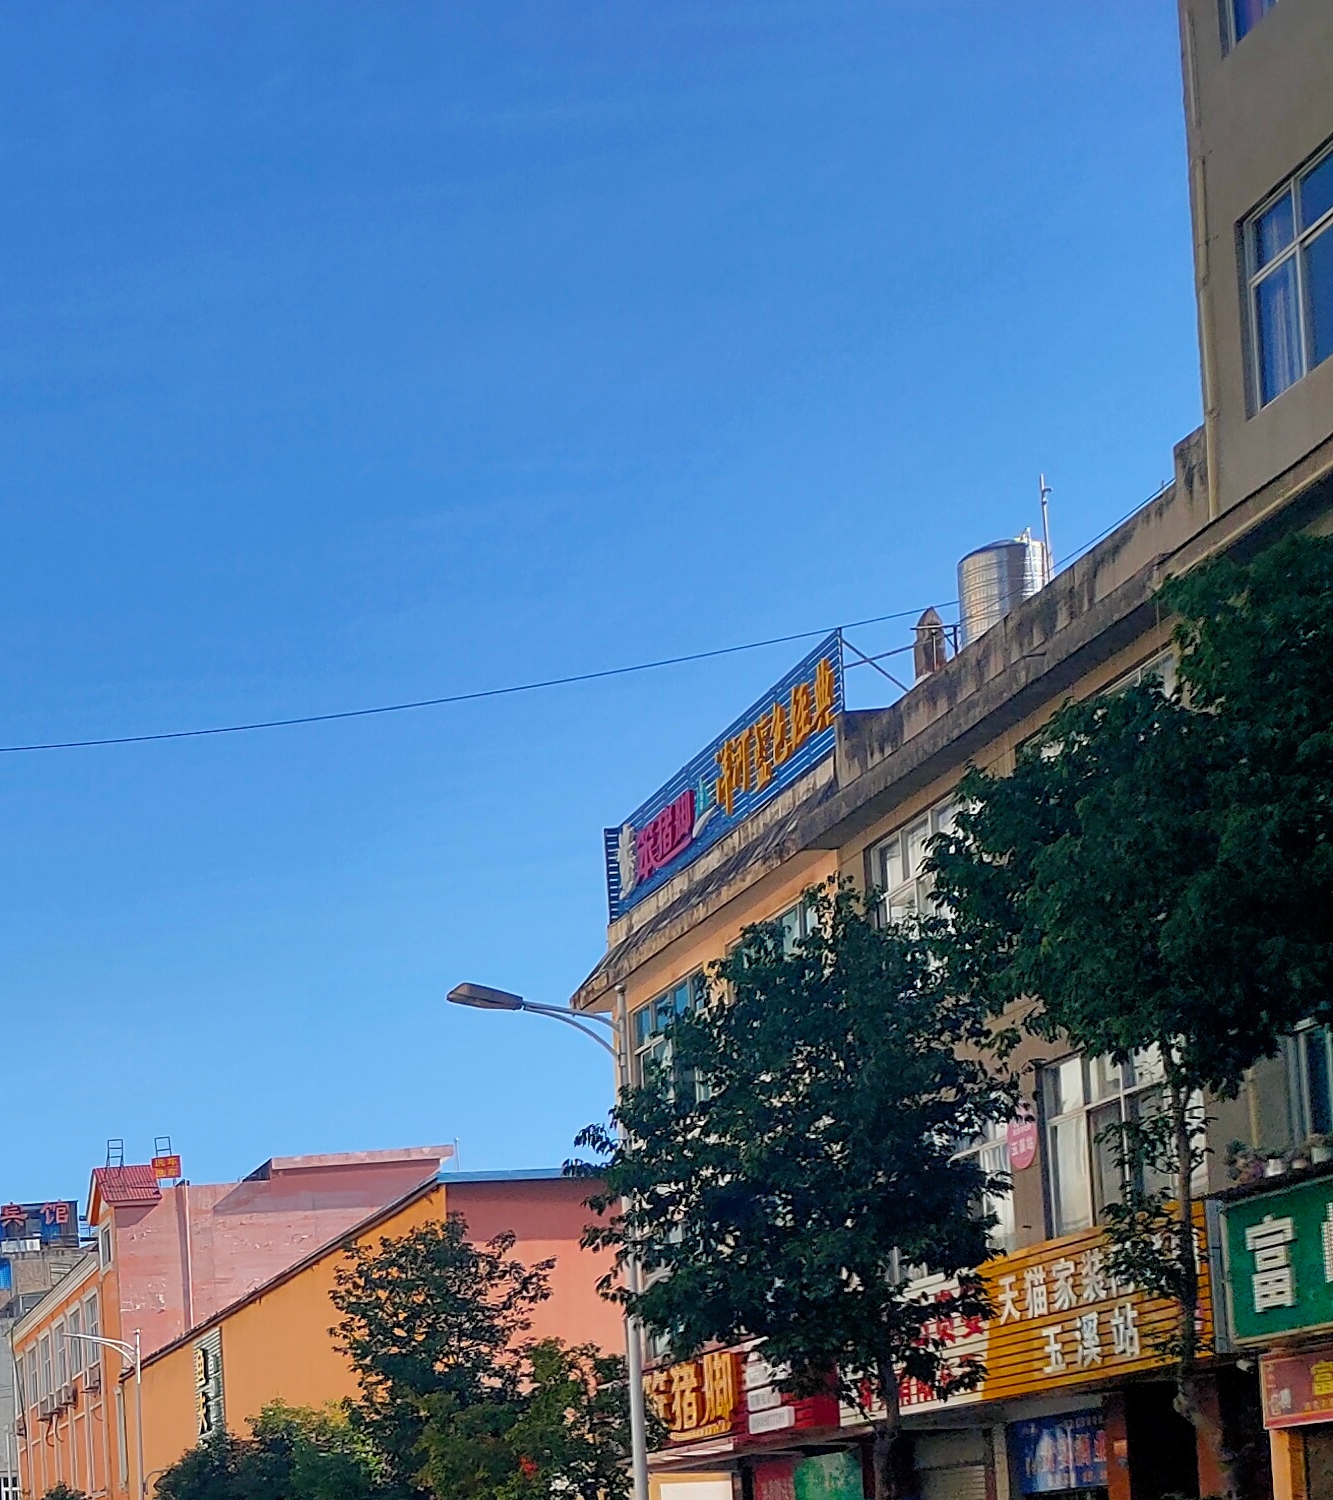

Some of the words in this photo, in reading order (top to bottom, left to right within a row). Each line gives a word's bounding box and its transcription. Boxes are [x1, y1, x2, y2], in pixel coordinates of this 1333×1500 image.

[0, 1202, 70, 1226] 宾馆
[1245, 1202, 1333, 1314] 富
[1042, 1303, 1141, 1374] 玉溪站
